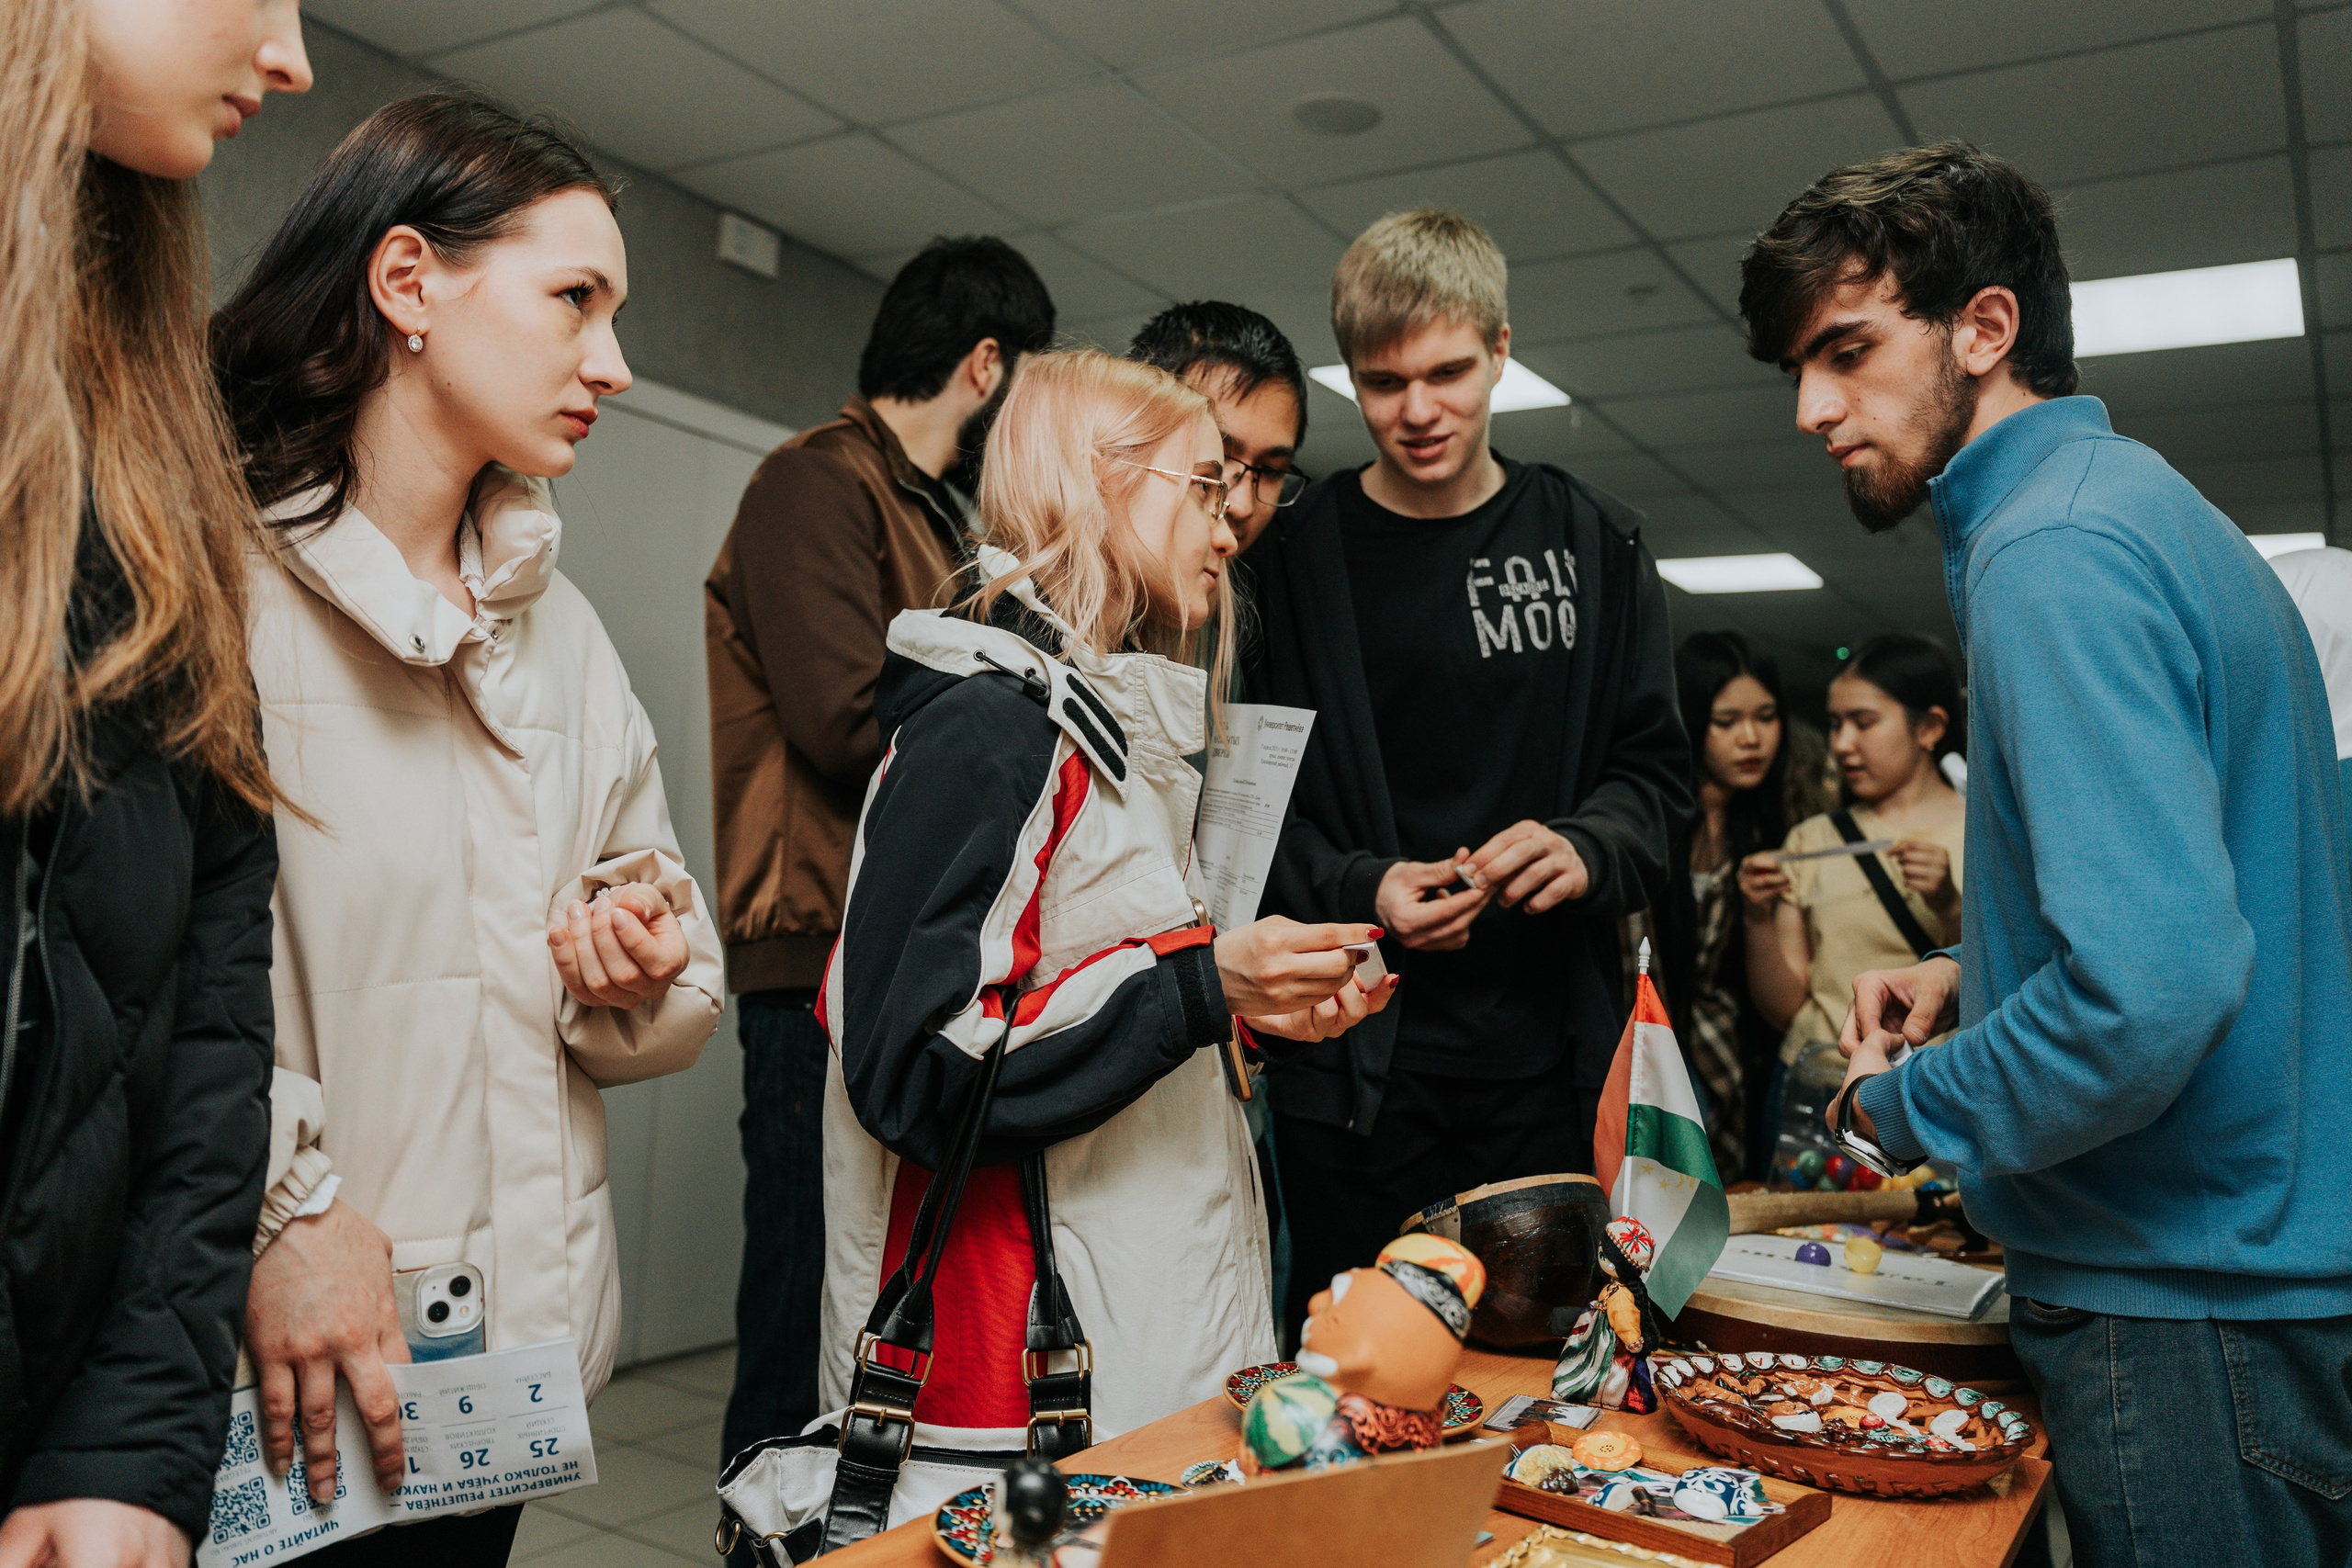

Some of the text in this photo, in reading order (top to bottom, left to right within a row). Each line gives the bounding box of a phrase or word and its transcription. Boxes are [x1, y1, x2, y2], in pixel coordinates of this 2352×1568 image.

[514, 1371, 552, 1384] БАССЕЙНА
[527, 1383, 543, 1403] 2
[458, 1395, 473, 1415] 9
[526, 1416, 555, 1428] СЕКЦИЙ
[445, 1427, 496, 1440] КОЛЛЕКТИВОВ
[516, 1425, 566, 1439] СПОРТИВНЫХ
[449, 1438, 494, 1450] ТВОРЧЕСКИХ
[529, 1437, 560, 1459] 25
[459, 1448, 491, 1470] 26
[561, 1461, 578, 1473] НЕ
[457, 1473, 500, 1491] УЧЁБА
[504, 1465, 558, 1482] ТОЛЬКО
[442, 1482, 452, 1492] И
[489, 1472, 581, 1498] УНИВЕРСИТЕТ
[405, 1490, 485, 1511] РЕШЕТНЁВА
[231, 1519, 339, 1568] ЧИТАЙТЕ О НАС
